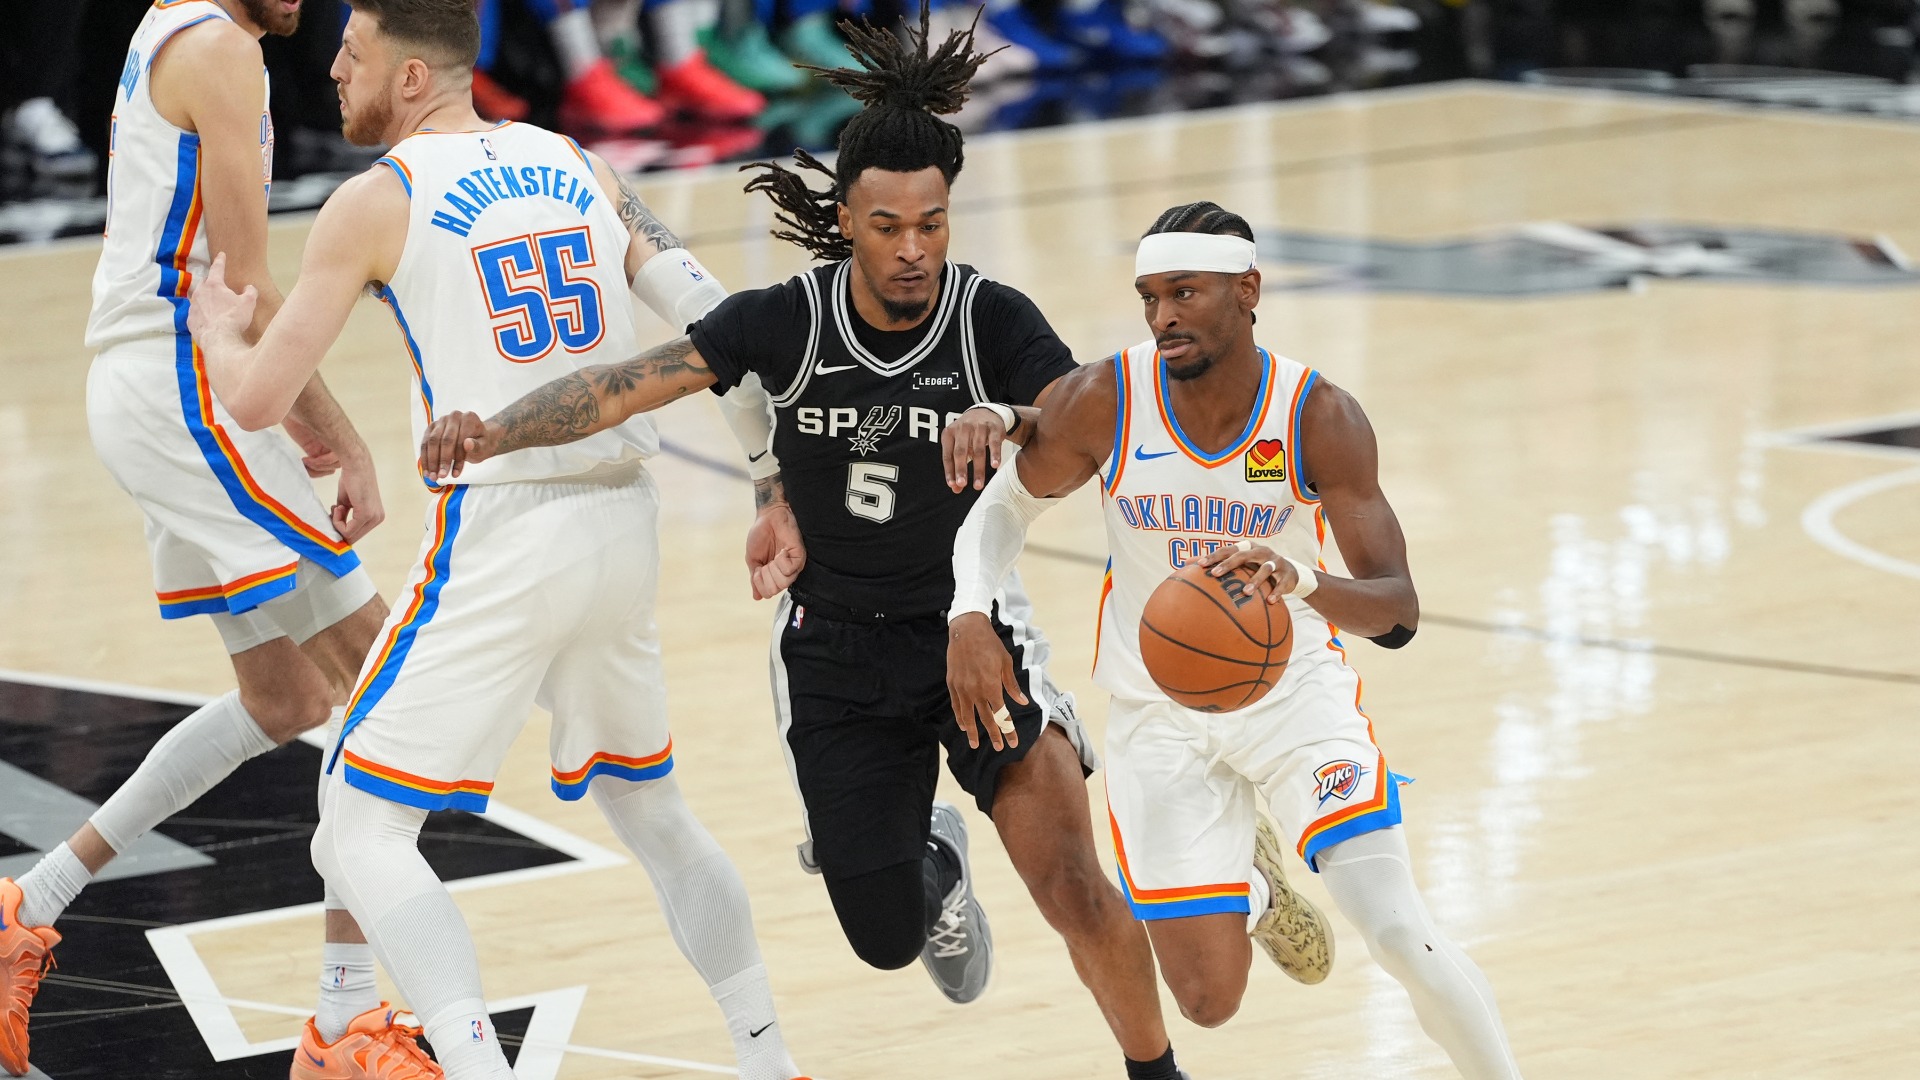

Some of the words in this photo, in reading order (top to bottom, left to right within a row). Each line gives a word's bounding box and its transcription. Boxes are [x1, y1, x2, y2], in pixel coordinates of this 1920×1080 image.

[431, 166, 595, 238] HARTENSTEIN
[470, 225, 606, 364] 55
[918, 377, 953, 386] LEDGER
[845, 462, 899, 524] 5
[1116, 494, 1295, 538] OKLAHOMA
[1168, 537, 1240, 570] CIT
[1319, 765, 1352, 799] OKC
